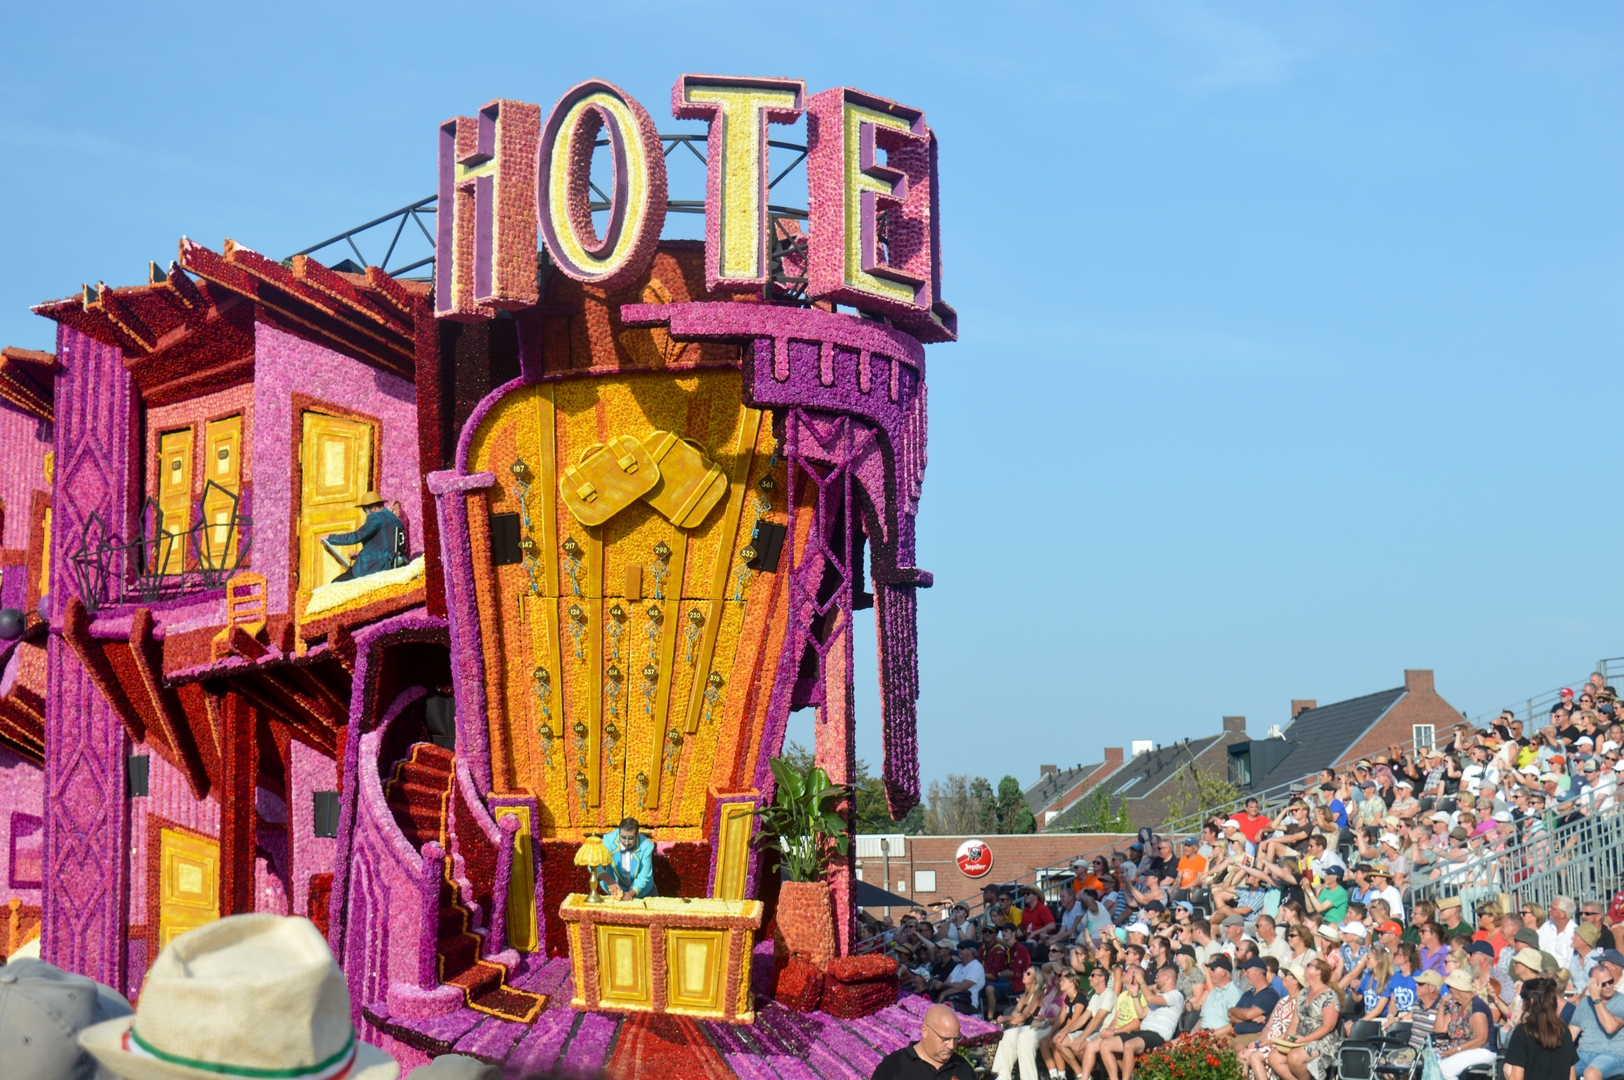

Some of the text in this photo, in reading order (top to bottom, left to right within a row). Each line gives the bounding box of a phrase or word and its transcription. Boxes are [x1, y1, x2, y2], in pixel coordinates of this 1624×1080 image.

[513, 465, 525, 473] 187
[761, 480, 774, 489] 361
[521, 541, 533, 549] 142
[564, 542, 576, 550] 217
[741, 549, 754, 558] 332
[964, 863, 987, 871] Jupiler
